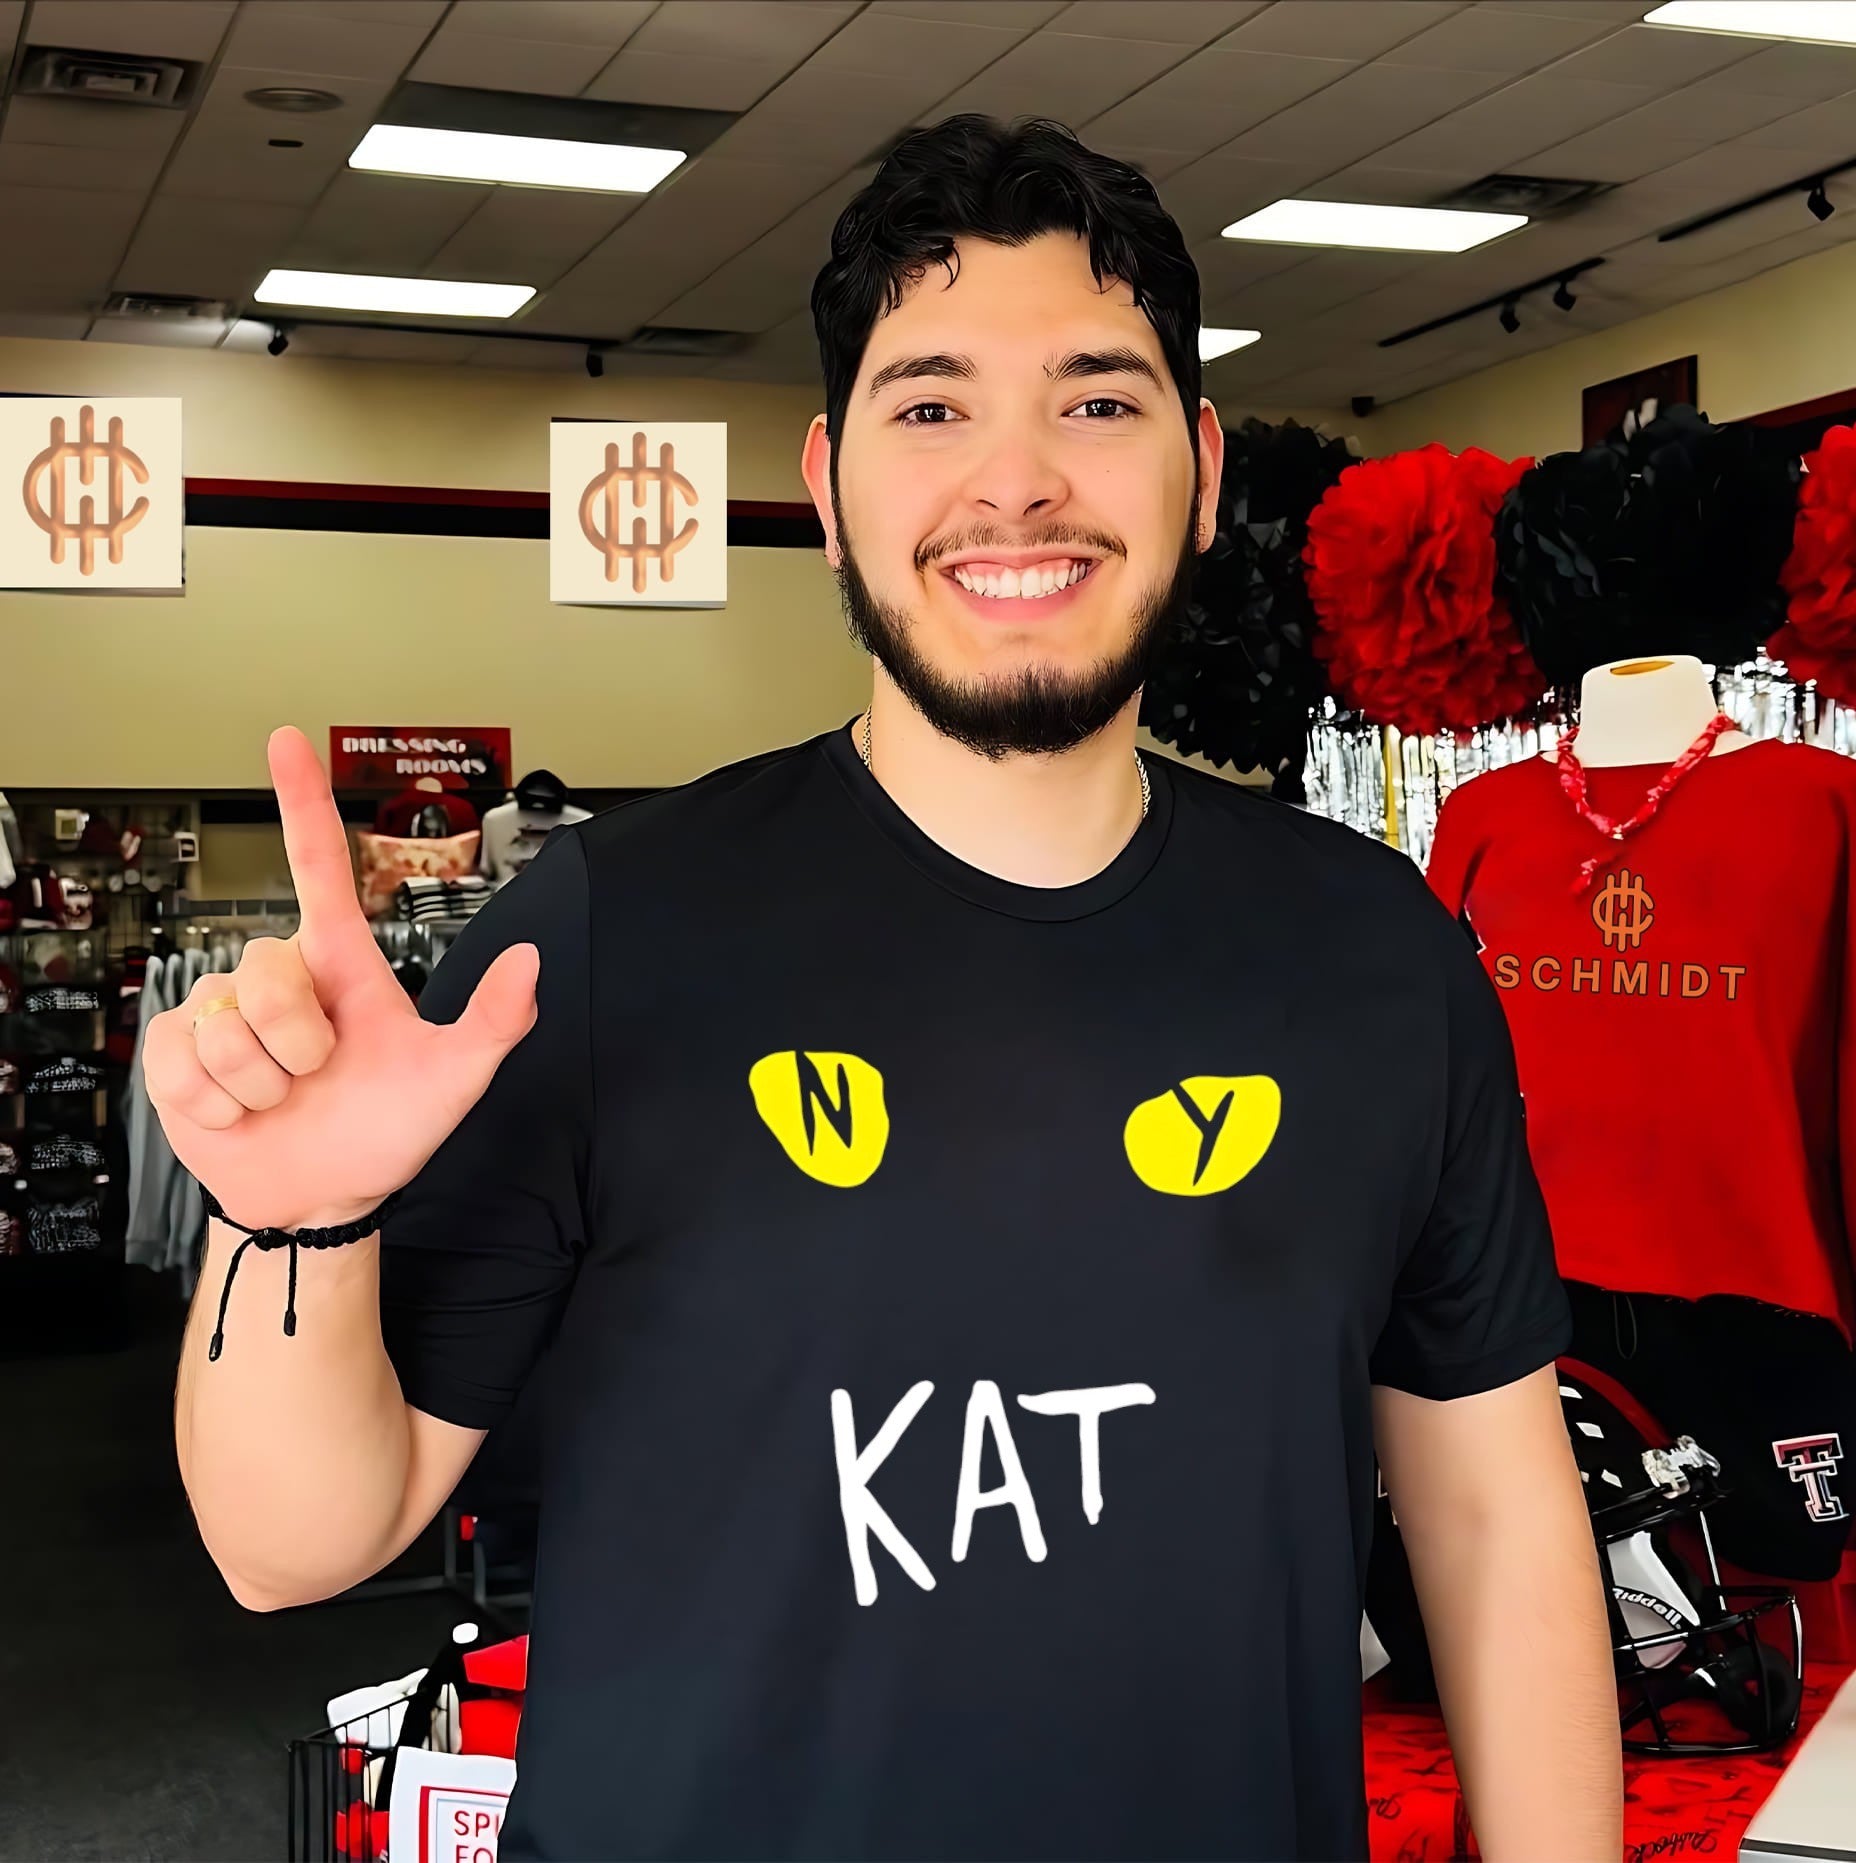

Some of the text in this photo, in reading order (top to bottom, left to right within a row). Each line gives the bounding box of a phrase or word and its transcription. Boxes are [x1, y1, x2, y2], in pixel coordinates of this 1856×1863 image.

[342, 737, 466, 753] DRESSING
[396, 758, 487, 774] ROOMS
[1494, 954, 1747, 1000] SCHMIDT
[794, 1050, 1236, 1188] N Y
[831, 1380, 1156, 1607] KAT
